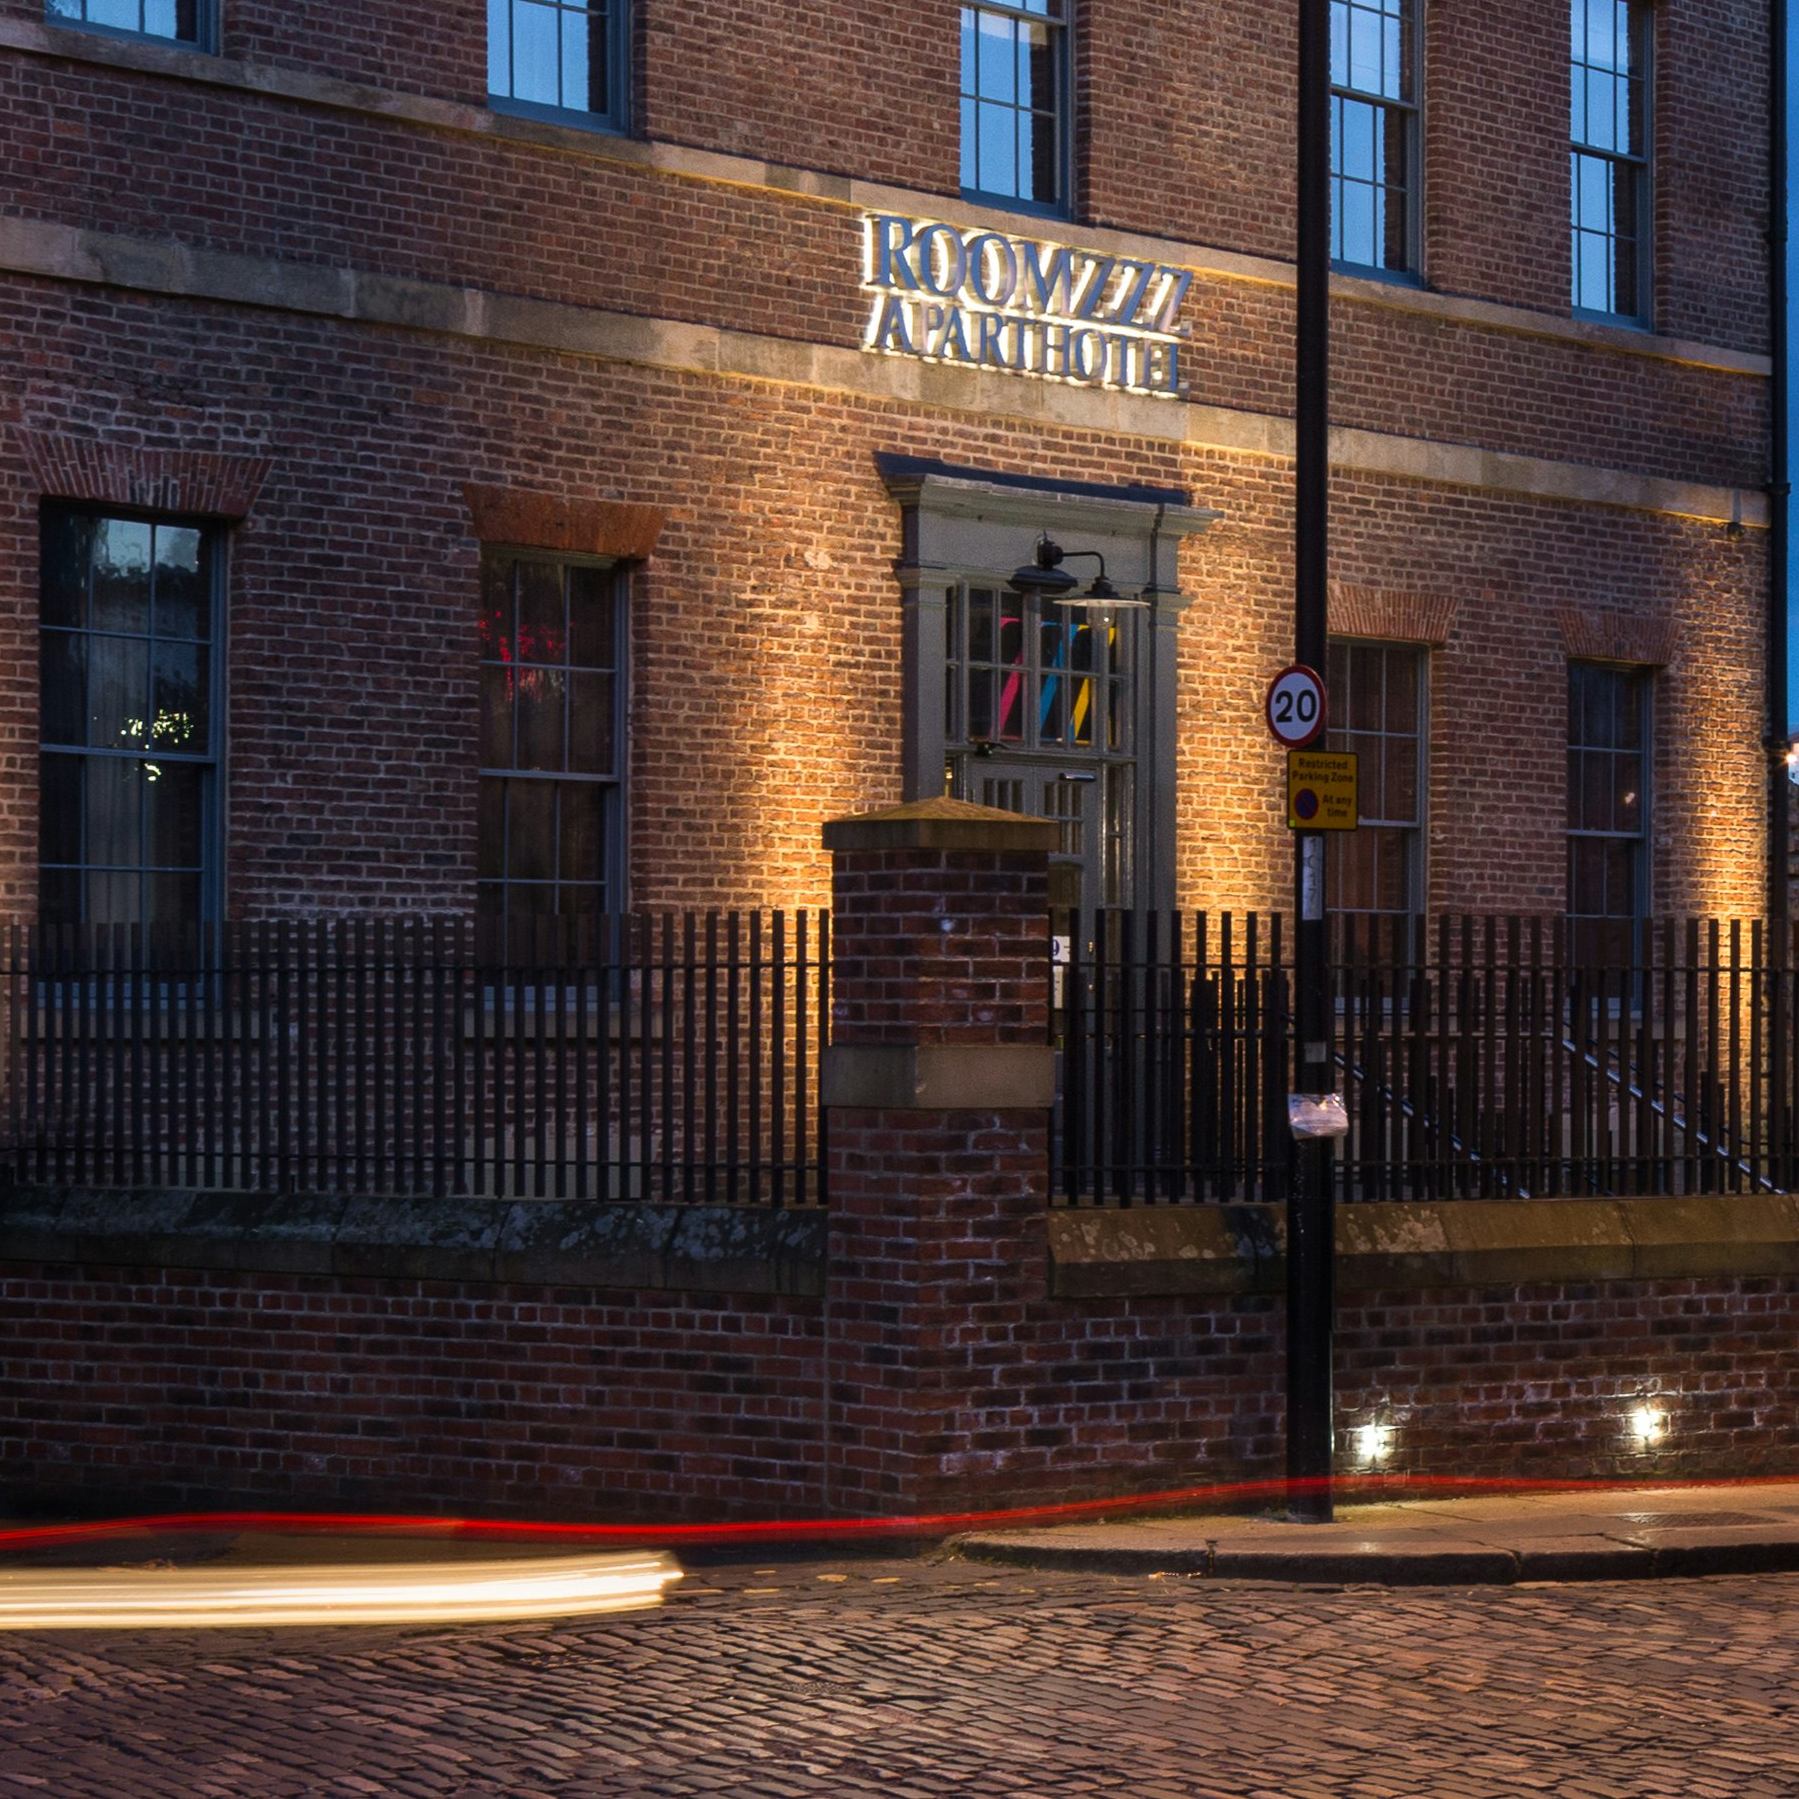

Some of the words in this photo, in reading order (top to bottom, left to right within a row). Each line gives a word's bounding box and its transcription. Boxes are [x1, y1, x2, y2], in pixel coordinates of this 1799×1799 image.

[864, 213, 1193, 338] ROOMZZZ
[1275, 689, 1317, 723] 20
[1298, 758, 1348, 770] Restricted
[1292, 771, 1329, 783] Parking
[1331, 772, 1353, 782] Zone
[1322, 794, 1333, 804] At
[1336, 796, 1353, 807] any
[1327, 808, 1347, 817] time
